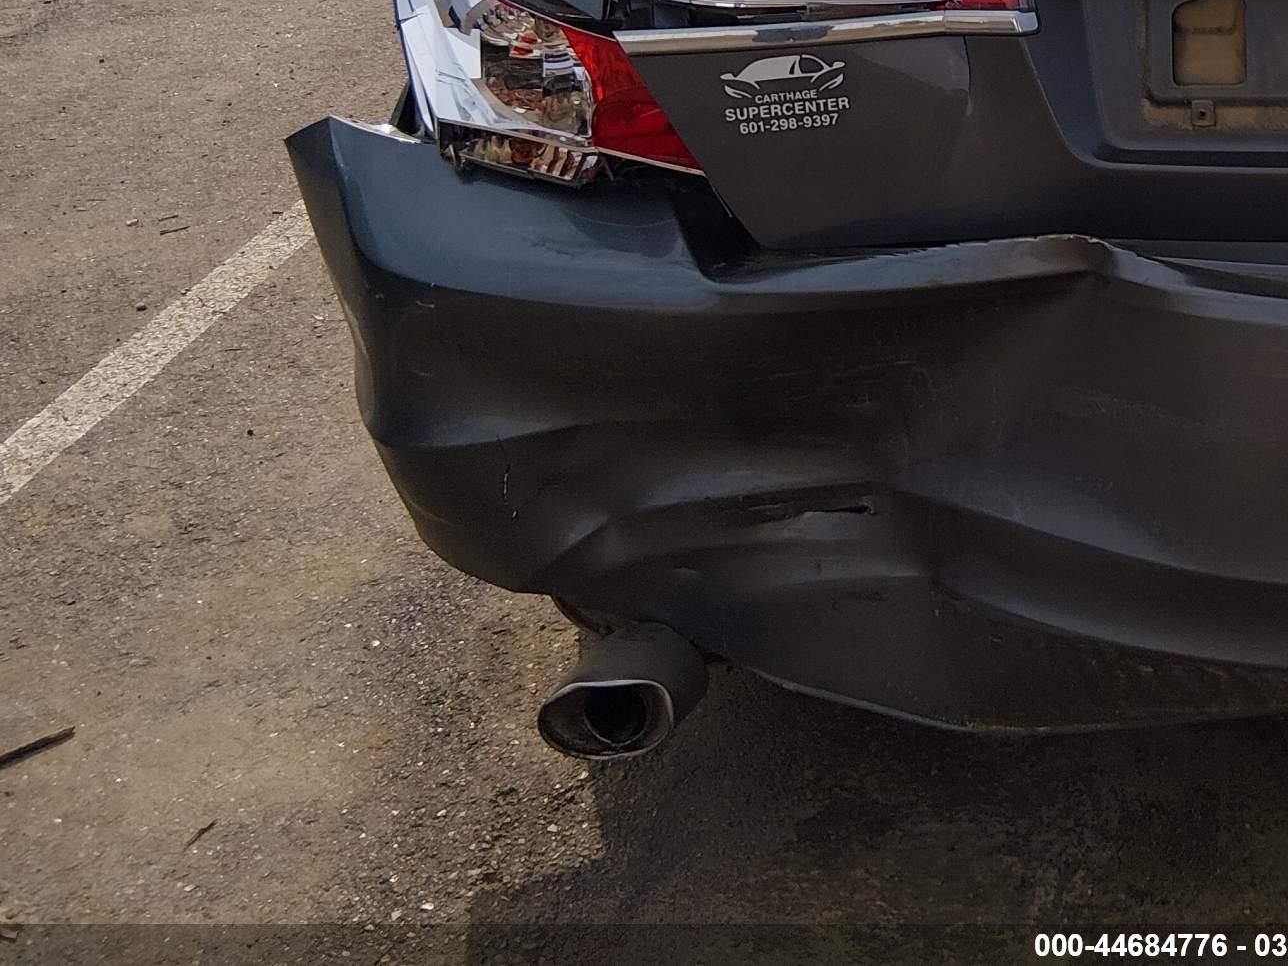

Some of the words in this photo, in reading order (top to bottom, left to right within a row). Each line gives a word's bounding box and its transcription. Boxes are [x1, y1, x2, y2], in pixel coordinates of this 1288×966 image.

[755, 89, 818, 104] CARTHAGE
[725, 96, 850, 121] SUPERCENTER
[740, 113, 839, 135] 601-298-9397
